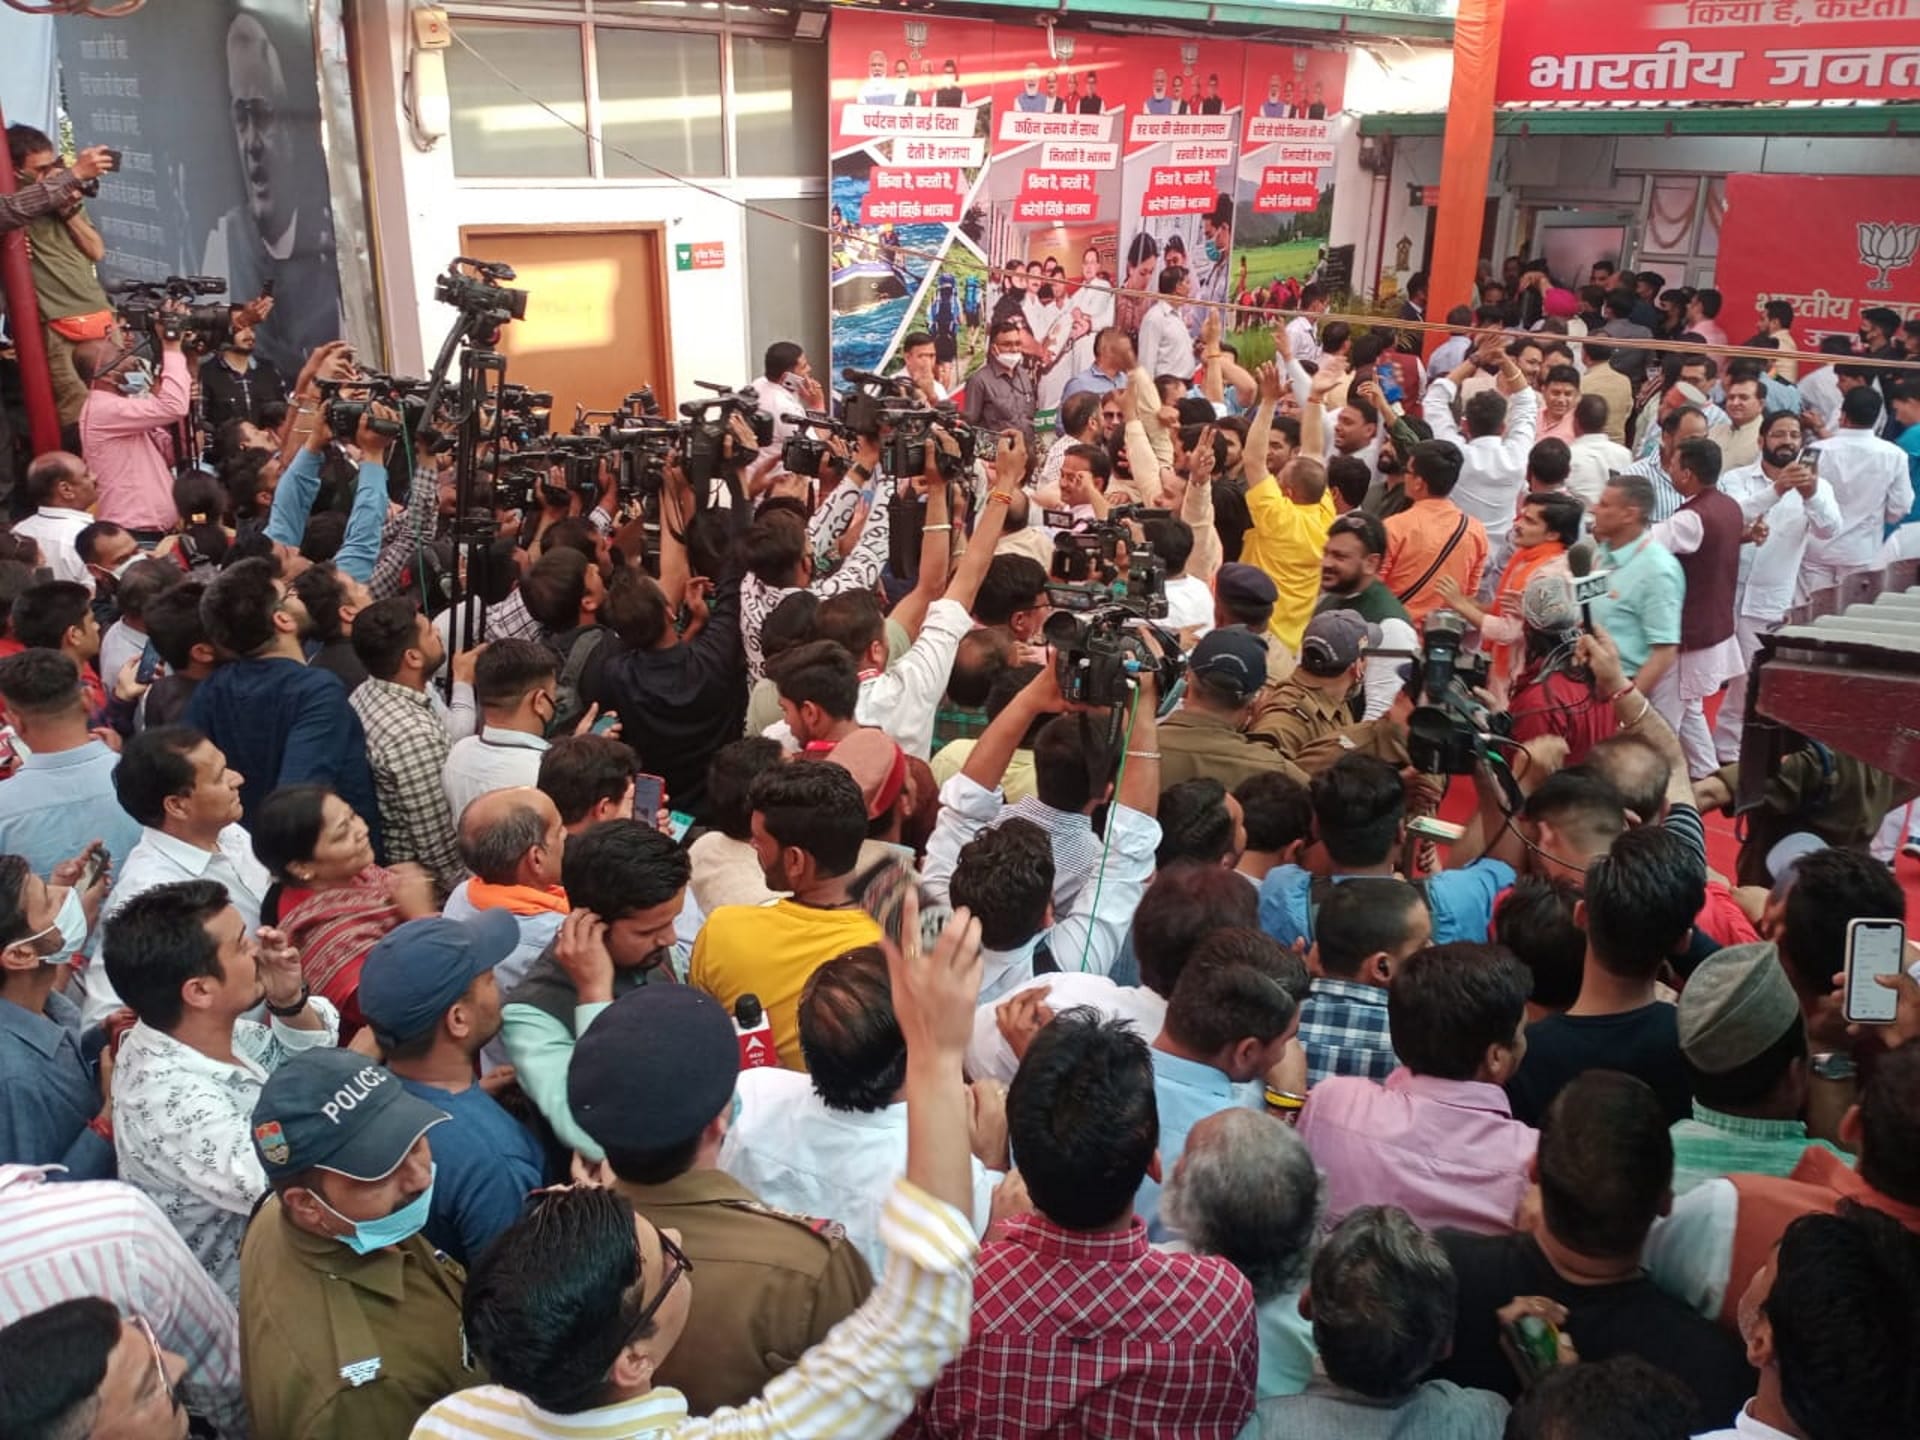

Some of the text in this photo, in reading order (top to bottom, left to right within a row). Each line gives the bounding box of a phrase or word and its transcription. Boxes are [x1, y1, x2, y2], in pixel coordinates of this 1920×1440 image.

[1529, 40, 1745, 90] भारतीय
[864, 111, 897, 129] पर्यटन
[915, 113, 932, 131] नई
[935, 113, 959, 131] दिशा
[1014, 118, 1041, 134] कठिन
[1043, 121, 1067, 135] समय
[1069, 119, 1080, 135] में
[906, 143, 971, 161] देती है भाजपा
[1087, 151, 1112, 162] भाजपा
[922, 203, 954, 217] भाजपा
[1065, 203, 1092, 215] भाजपा
[1755, 289, 1854, 319] भरतीय
[321, 1066, 388, 1125] POLICE
